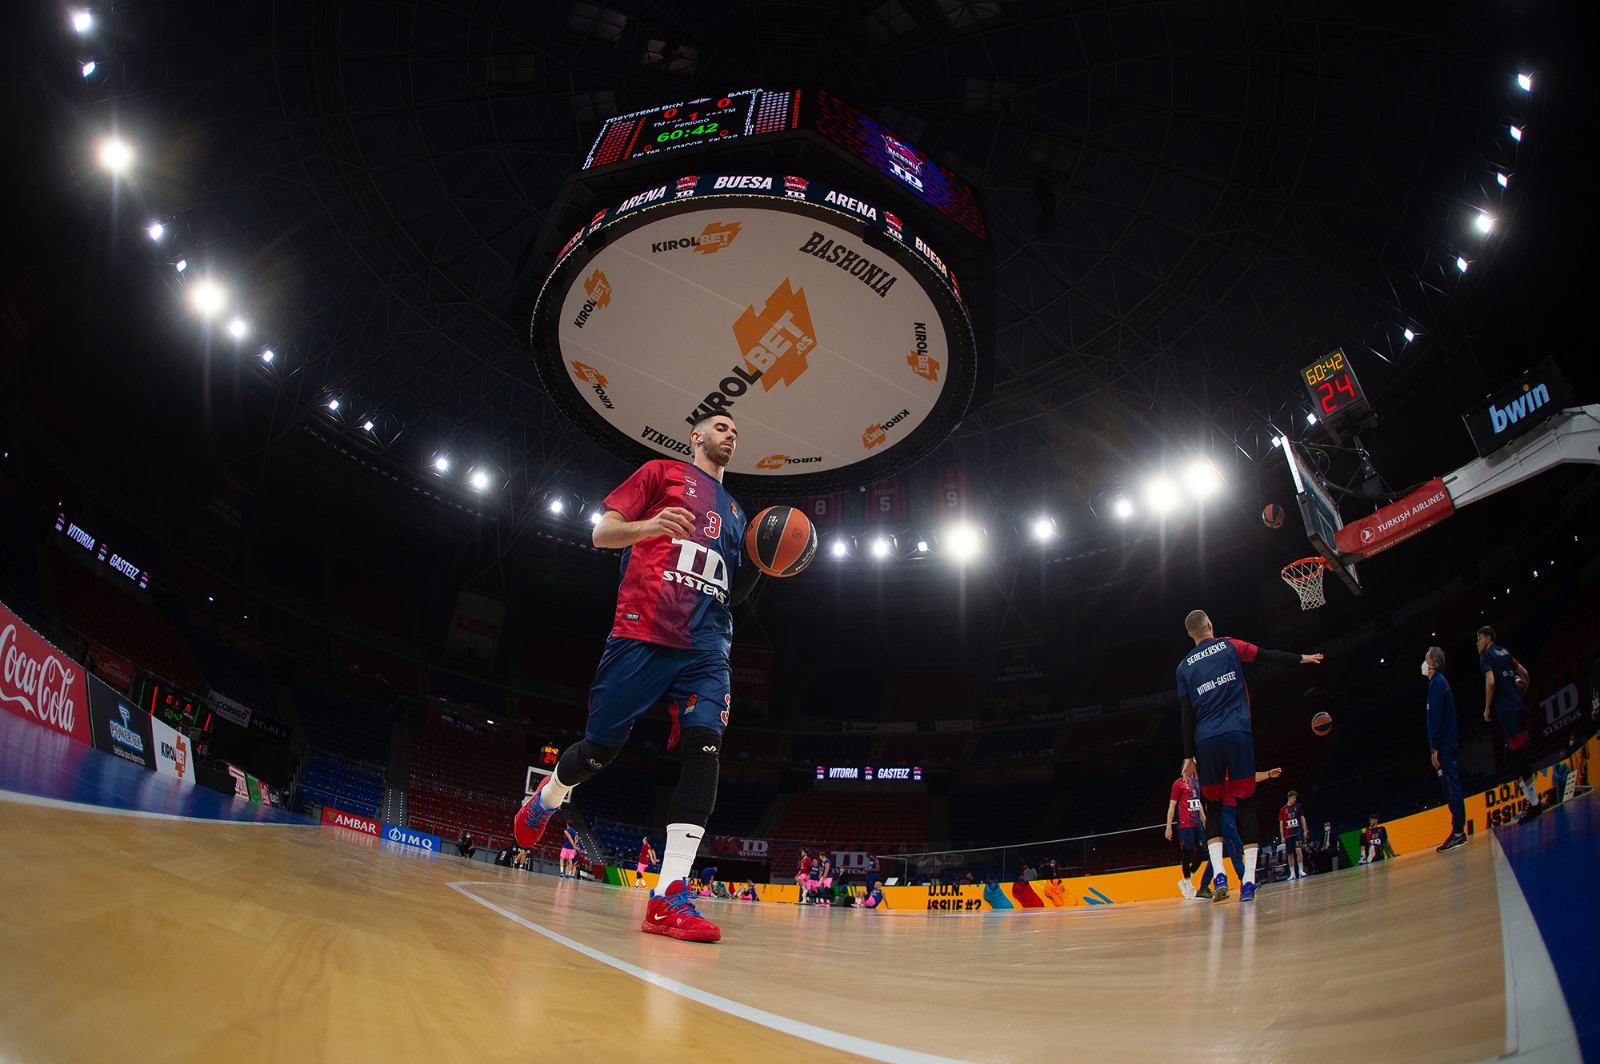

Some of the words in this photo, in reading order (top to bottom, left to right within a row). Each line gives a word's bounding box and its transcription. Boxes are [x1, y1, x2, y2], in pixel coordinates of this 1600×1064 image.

[661, 101, 684, 111] BKN
[717, 97, 731, 108] 0
[664, 108, 678, 119] 0
[675, 118, 710, 129] PERIODO
[688, 112, 698, 121] 1
[657, 122, 719, 143] 60:42
[713, 175, 773, 190] BUESA
[616, 185, 667, 215] ARENA
[824, 190, 878, 221] ARENA
[651, 231, 733, 253] KIROLBET
[799, 231, 898, 298] BASKONIA
[915, 236, 948, 278] BUESA
[574, 279, 608, 329] KIROLBET
[796, 335, 814, 355] .es
[914, 322, 931, 376] KIROLBET
[1305, 352, 1345, 387] 60:42
[1318, 374, 1356, 414] 24
[1488, 382, 1551, 434] bwin
[814, 500, 827, 516] 8
[879, 496, 892, 512] 5
[945, 490, 958, 507] 9
[1377, 510, 1411, 533] TURKISH
[1411, 491, 1445, 515] AIRLINES
[703, 511, 722, 539] 3
[66, 522, 96, 552] VITORIA
[109, 553, 140, 581] GASTEIZ
[671, 537, 729, 591] TD
[663, 571, 726, 604] SYSTEMS
[1186, 641, 1227, 666] SEDEKERSKIS
[217, 701, 248, 720] CORREO
[1538, 683, 1580, 725] TD
[252, 718, 281, 736] KELME
[1543, 709, 1582, 738] SYSTEMS
[109, 720, 144, 752] POWERADE
[544, 754, 557, 764] 24
[829, 767, 859, 779] VITORIA
[877, 768, 910, 780] GASTEIZ
[334, 814, 377, 835] AMBAR
[401, 833, 433, 851] IMQ
[739, 839, 769, 852] TD
[830, 851, 868, 868] TD
[927, 899, 964, 910] ISSUE
